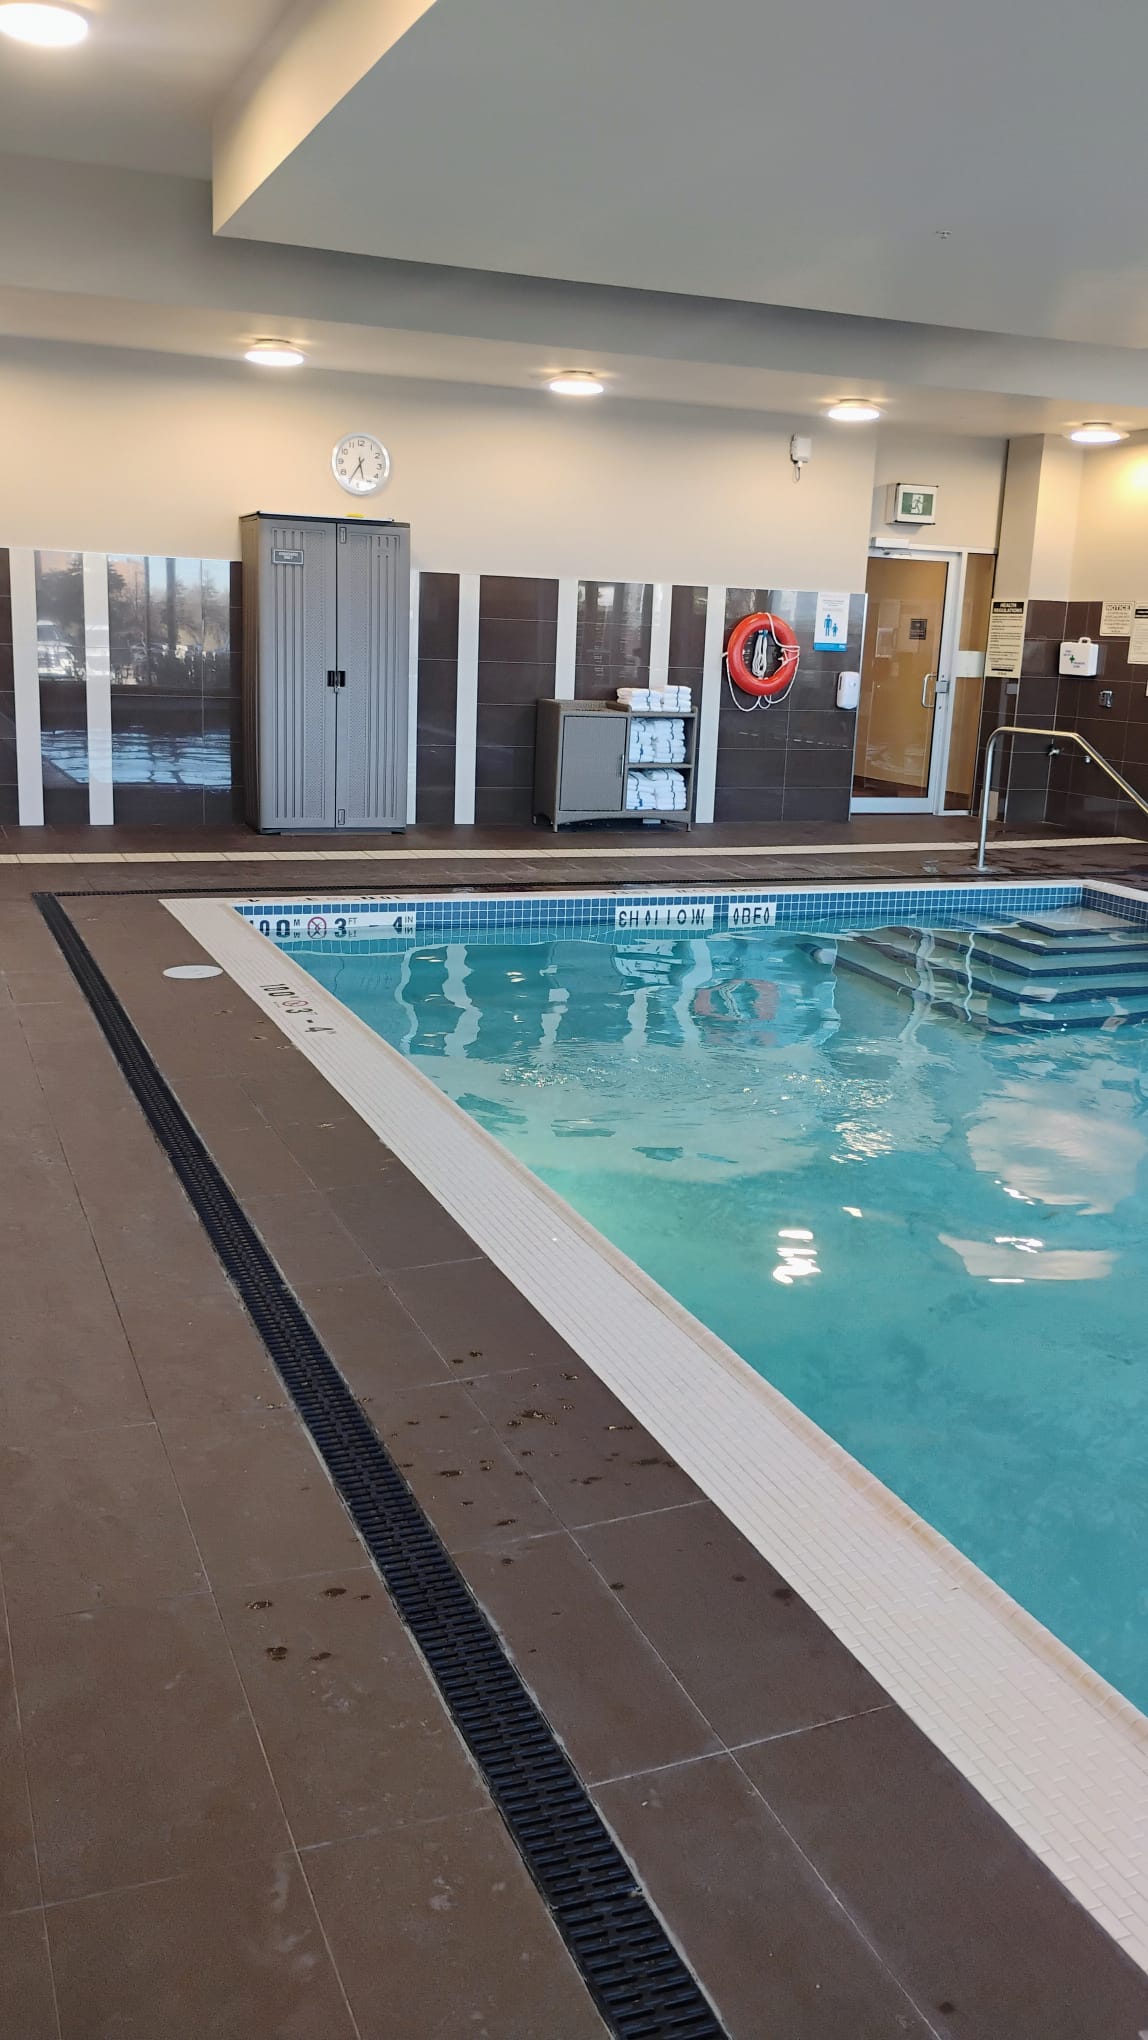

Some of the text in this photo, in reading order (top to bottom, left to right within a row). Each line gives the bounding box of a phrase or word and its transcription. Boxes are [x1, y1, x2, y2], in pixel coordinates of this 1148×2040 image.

[357, 439, 366, 447] 12
[341, 448, 349, 456] 10
[348, 917, 358, 925] FT
[404, 915, 414, 923] IN
